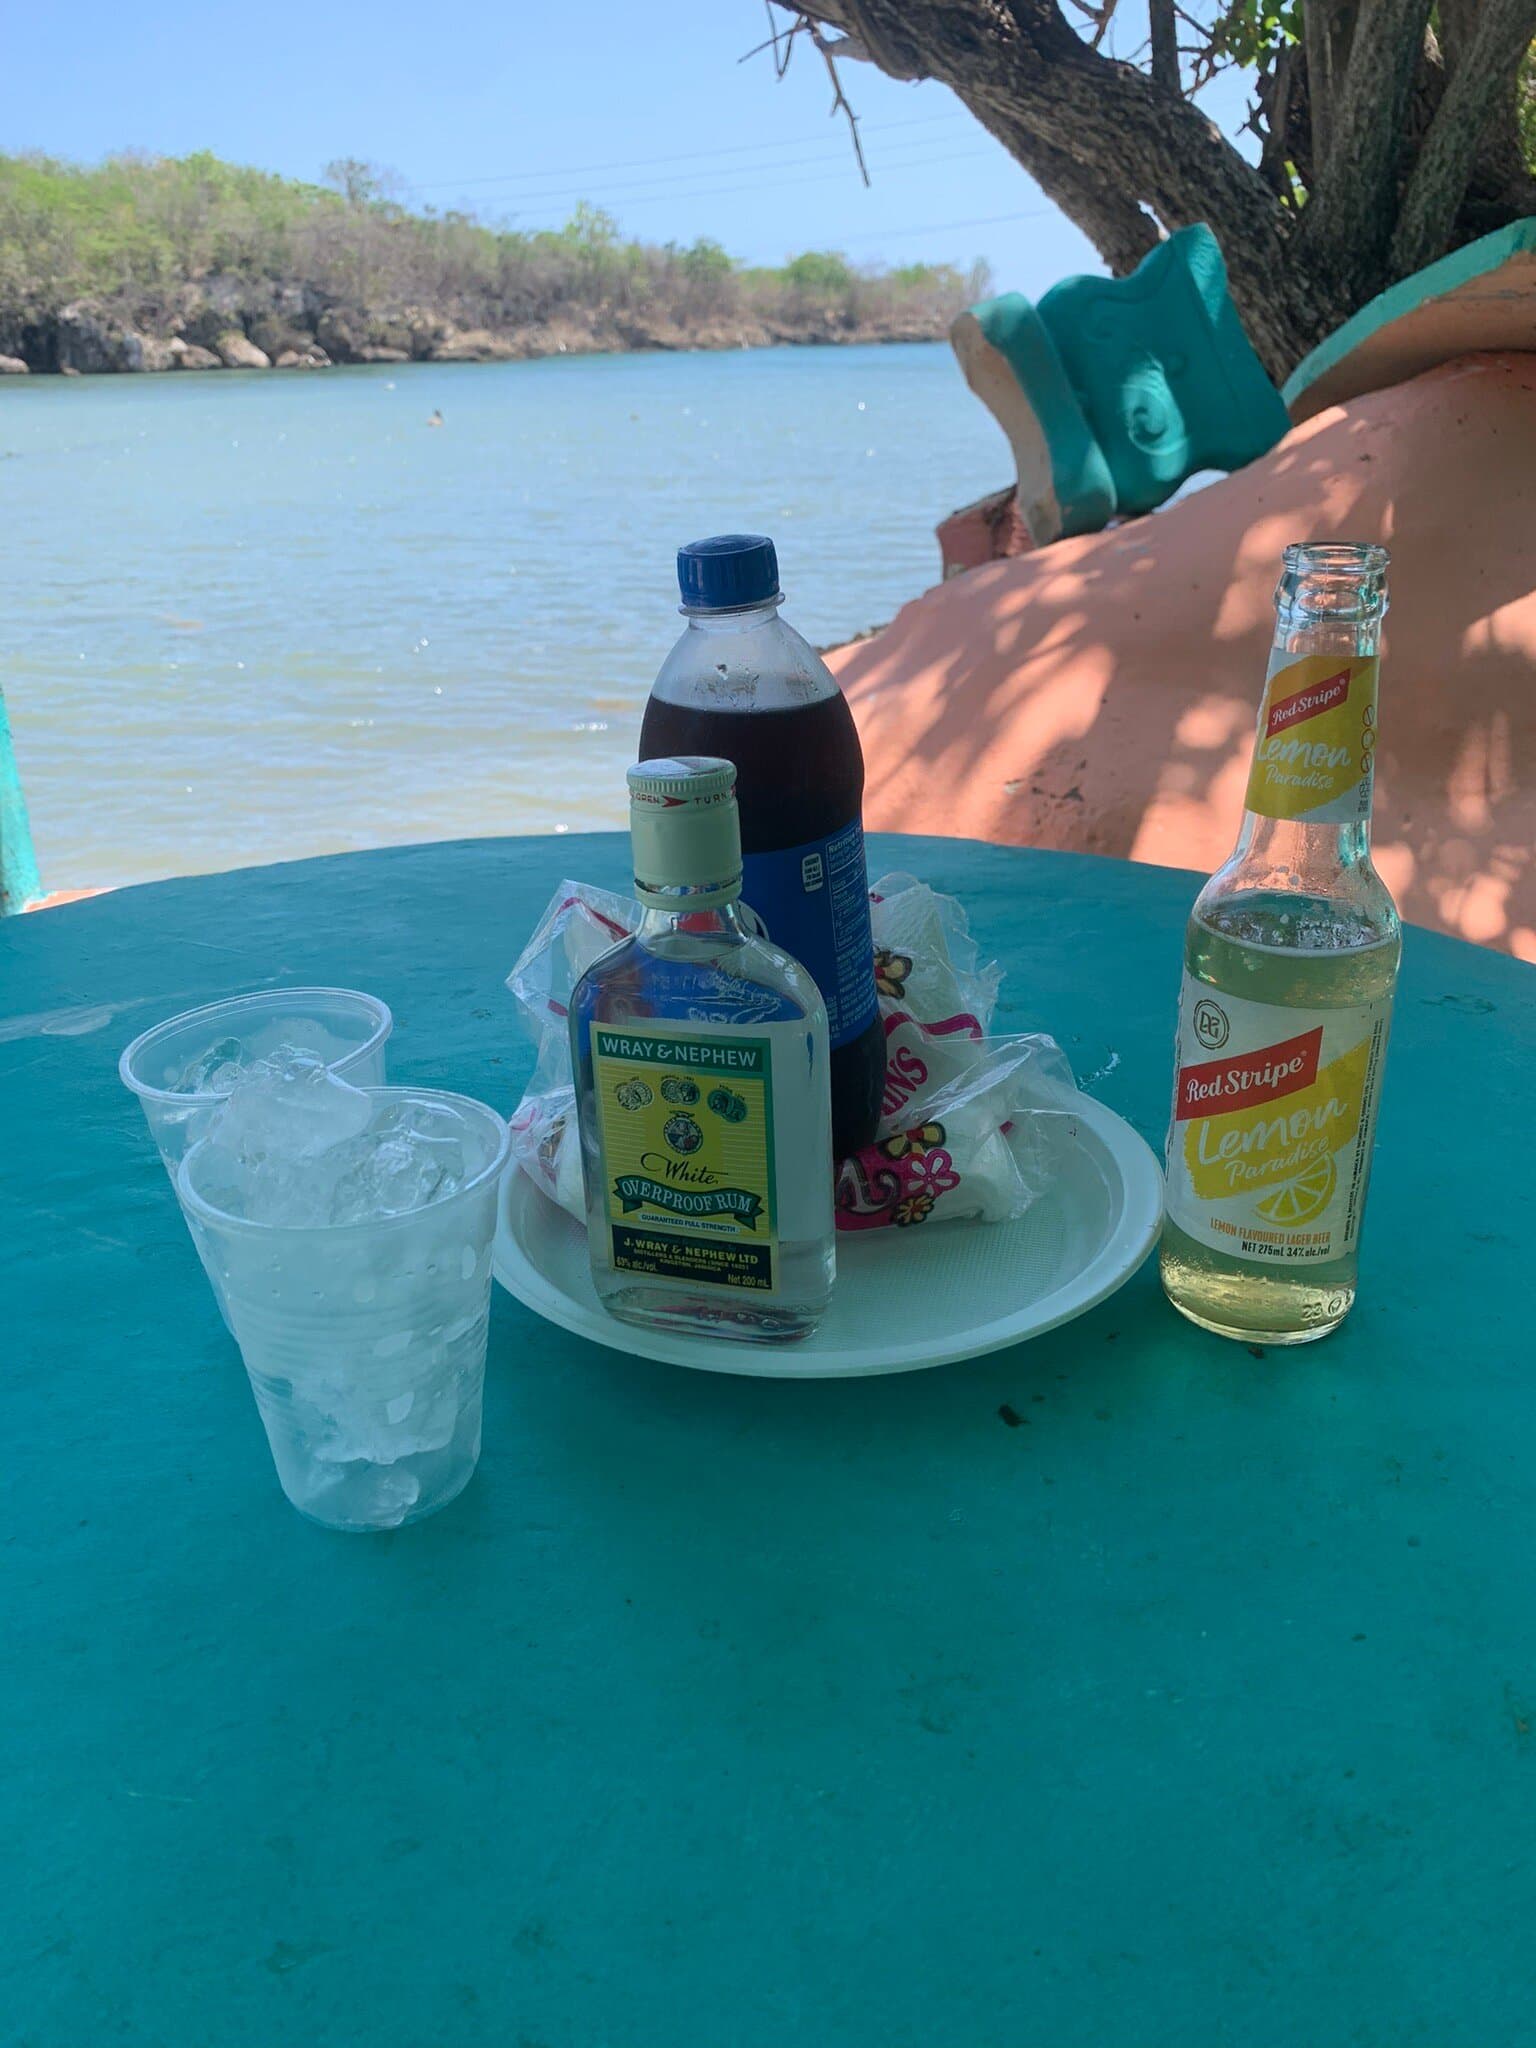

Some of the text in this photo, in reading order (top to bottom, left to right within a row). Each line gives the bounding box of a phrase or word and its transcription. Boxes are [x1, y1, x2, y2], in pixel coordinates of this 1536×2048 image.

[1271, 686, 1342, 726] Red Stripe
[1257, 737, 1352, 769] Lemon
[1265, 763, 1334, 789] Paradise
[694, 791, 727, 804] TURN
[602, 1036, 757, 1067] WRAY & NEPHEW
[1185, 1055, 1306, 1104] Red Stripe
[1198, 1097, 1348, 1165] Lemon
[640, 1152, 729, 1185] White
[1224, 1136, 1330, 1187] Paradise
[621, 1179, 753, 1213] OVERPROOF RUM
[641, 1213, 683, 1226] GUARANTEED
[701, 1220, 736, 1232] STRENGTH
[1210, 1217, 1331, 1245] LEMON FLAVOURED LAGER BEER
[635, 1239, 668, 1252] WRAY
[672, 1244, 682, 1254] &
[685, 1246, 737, 1262] NEPHEW
[739, 1253, 758, 1265] LTD
[1241, 1240, 1257, 1253] NET
